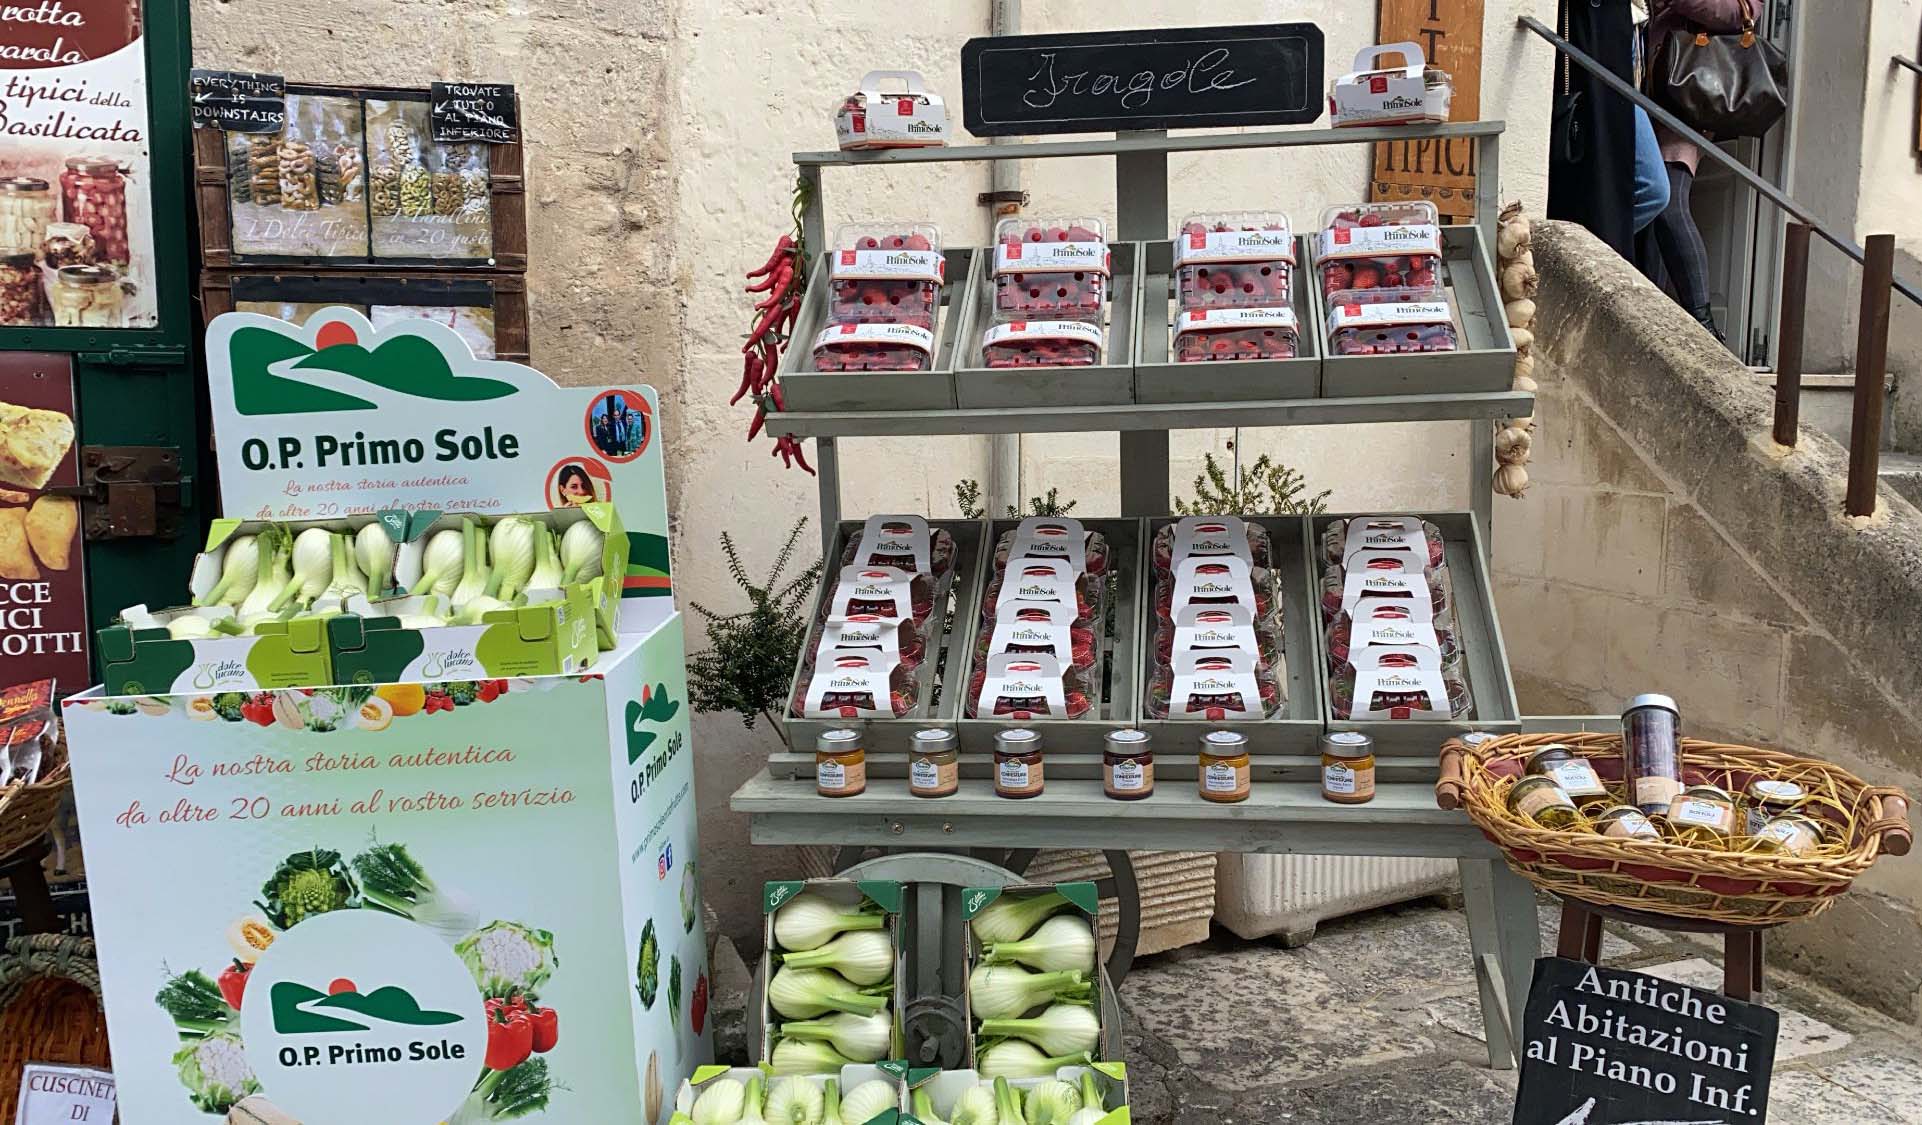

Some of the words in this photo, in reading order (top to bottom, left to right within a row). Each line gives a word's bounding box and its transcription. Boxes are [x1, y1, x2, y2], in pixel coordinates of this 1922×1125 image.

[0, 0, 85, 26] rotta
[193, 76, 279, 92] EVERYTHING
[444, 85, 502, 97] TROVATE
[1023, 48, 1257, 109] Fragole
[6, 75, 88, 109] tipici
[89, 92, 131, 108] della
[231, 93, 246, 104] IS
[192, 106, 284, 123] DOWNSTAIRS
[445, 112, 461, 123] AL
[439, 127, 511, 138] INFERIORE
[418, 229, 445, 243] 20
[241, 437, 303, 471] O.P.
[315, 431, 425, 467] Primo
[434, 425, 520, 463] Sole
[281, 480, 302, 497] La
[307, 480, 351, 493] nostra
[357, 478, 397, 490] storia
[401, 473, 470, 488] autentica
[256, 504, 273, 521] da
[278, 503, 310, 517] oltre
[316, 501, 338, 516] 20
[343, 502, 379, 515] anni
[446, 497, 501, 510] servizio
[0, 631, 83, 656] OTTI
[165, 754, 202, 785] La
[212, 754, 295, 777] nostra
[304, 751, 379, 774] storia
[387, 744, 517, 768] autentica
[645, 750, 667, 787] Primo
[667, 730, 682, 761] Sole
[116, 800, 150, 829] da
[158, 795, 219, 825] oltre
[229, 796, 270, 821] 20
[280, 796, 341, 818] anni
[350, 788, 385, 816] al
[387, 789, 464, 812] vostro
[471, 786, 576, 811] servizio
[1574, 966, 1728, 1025] Antiche
[1544, 999, 1750, 1074] Abitazioni
[278, 1046, 321, 1067] O.P.
[328, 1043, 402, 1065] Primo
[408, 1039, 466, 1062] Sole
[1526, 1036, 1558, 1065] al
[1568, 1042, 1678, 1095] Piano
[1687, 1072, 1758, 1117] Inf.
[70, 1104, 90, 1122] DI
